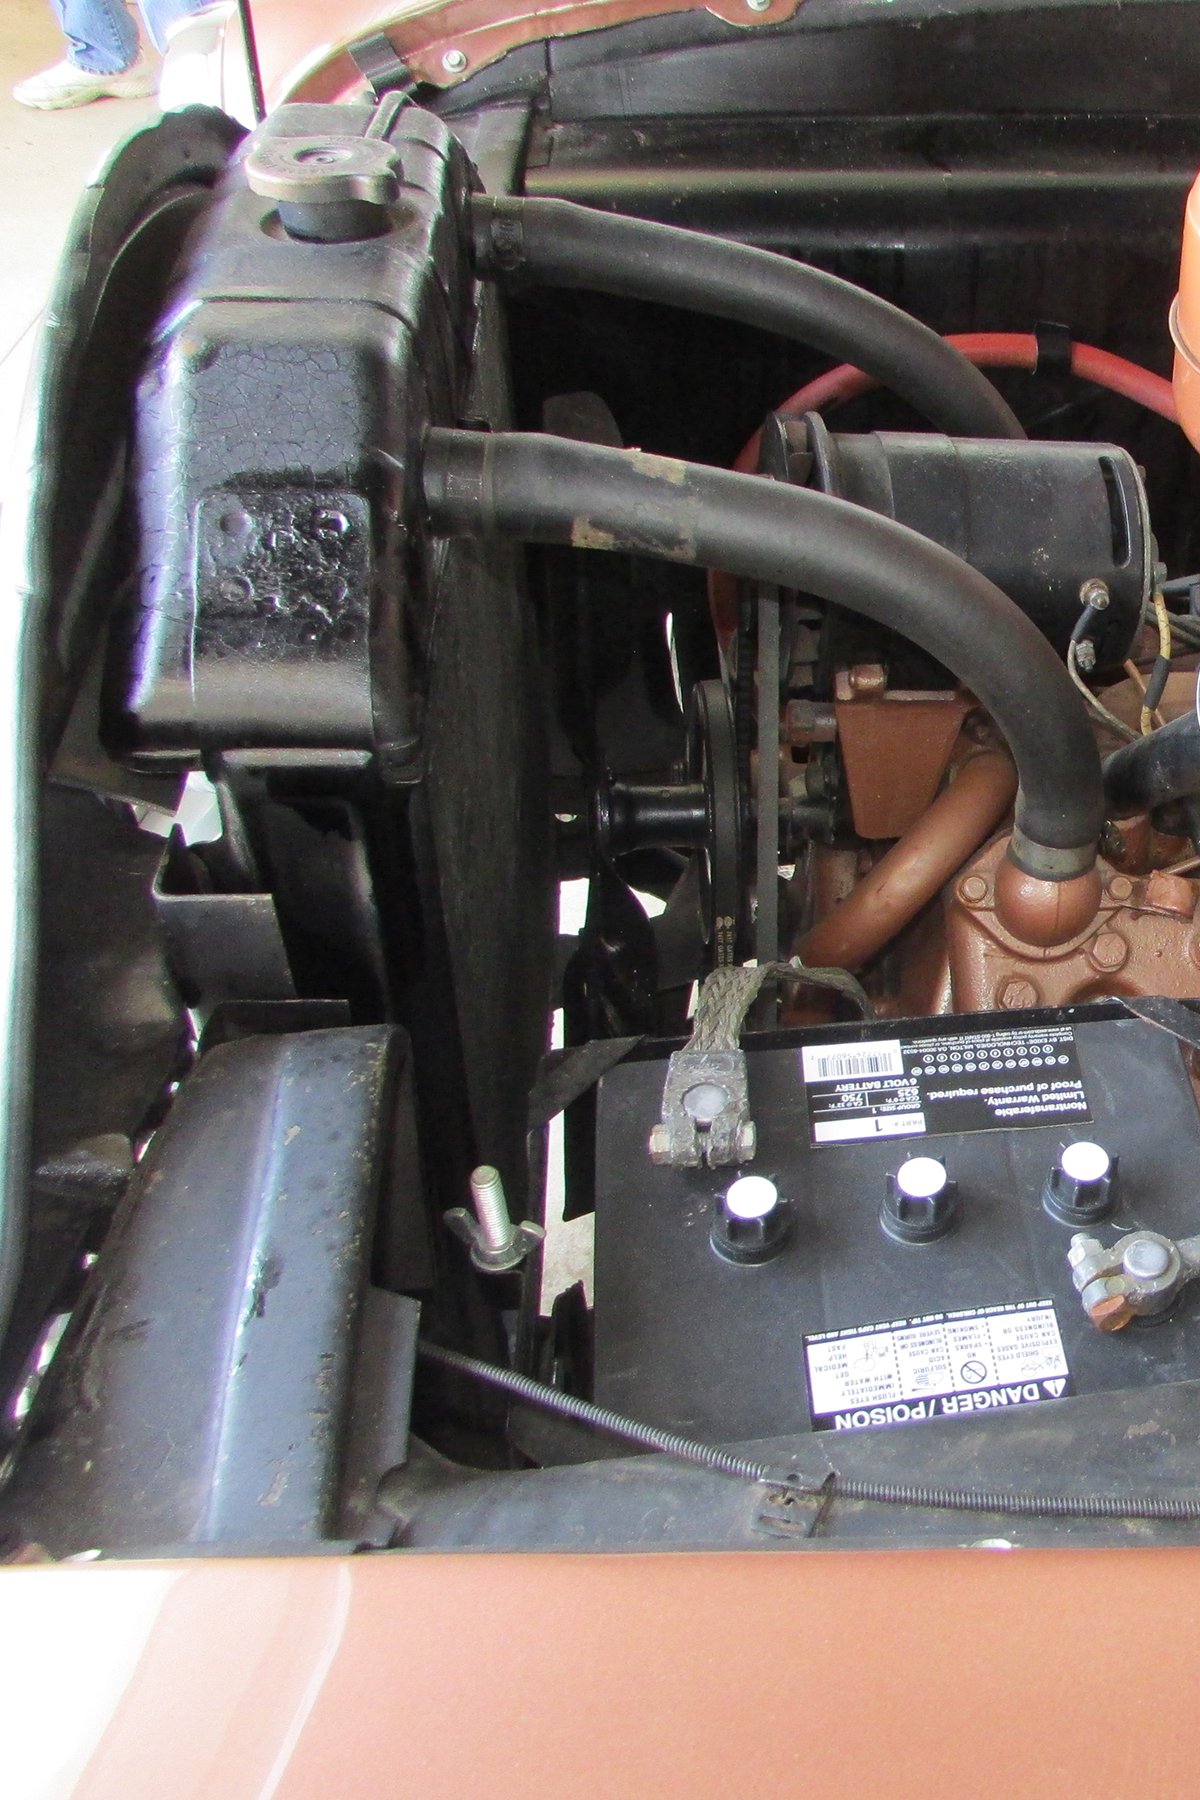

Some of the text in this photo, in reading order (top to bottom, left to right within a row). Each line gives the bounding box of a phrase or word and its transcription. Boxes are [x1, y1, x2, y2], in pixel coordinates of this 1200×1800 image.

[833, 1077, 917, 1092] 6 VOLT BATTERY
[925, 1079, 1082, 1100] Proof of purchase required.
[840, 1092, 863, 1102] 750
[896, 1087, 919, 1097] 625
[983, 1090, 1085, 1107] Limited Warranty.
[896, 1102, 921, 1110] GROUP
[993, 1100, 1087, 1117] Nontransferable
[873, 1118, 883, 1132] 1
[901, 1118, 922, 1127] PART
[1004, 1303, 1016, 1311] THE
[1024, 1300, 1037, 1308] OUT
[976, 1307, 984, 1315] OF
[1025, 1313, 1052, 1322] INJURY
[946, 1323, 978, 1334] SMOKING
[1013, 1321, 1053, 1333] BLINDNESS
[804, 1332, 825, 1342] LEVEL.
[896, 1329, 940, 1341] SEVERE BURNS
[952, 1332, 980, 1342] FLAMES
[1015, 1329, 1056, 1341] CAN CAUSE
[826, 1343, 845, 1352] FAST
[909, 1337, 942, 1348] BLINDNESS
[954, 1341, 982, 1351] SPARKS
[995, 1337, 1057, 1352] EXPLOSIVE GASES
[827, 1352, 847, 1361] HELP
[907, 1346, 943, 1357] CAN CAUSE
[996, 1348, 1039, 1361] SHIELD EYES
[928, 1354, 944, 1363] ACID
[813, 1361, 847, 1372] MEDICAL
[912, 1363, 946, 1374] SULFURIC
[834, 1370, 849, 1379] GET
[843, 1373, 892, 1386] WITH WATER
[840, 1382, 894, 1396] IMMEDIATELY
[849, 1391, 896, 1404] FLUSH EYES
[940, 1382, 1040, 1413] DANGER
